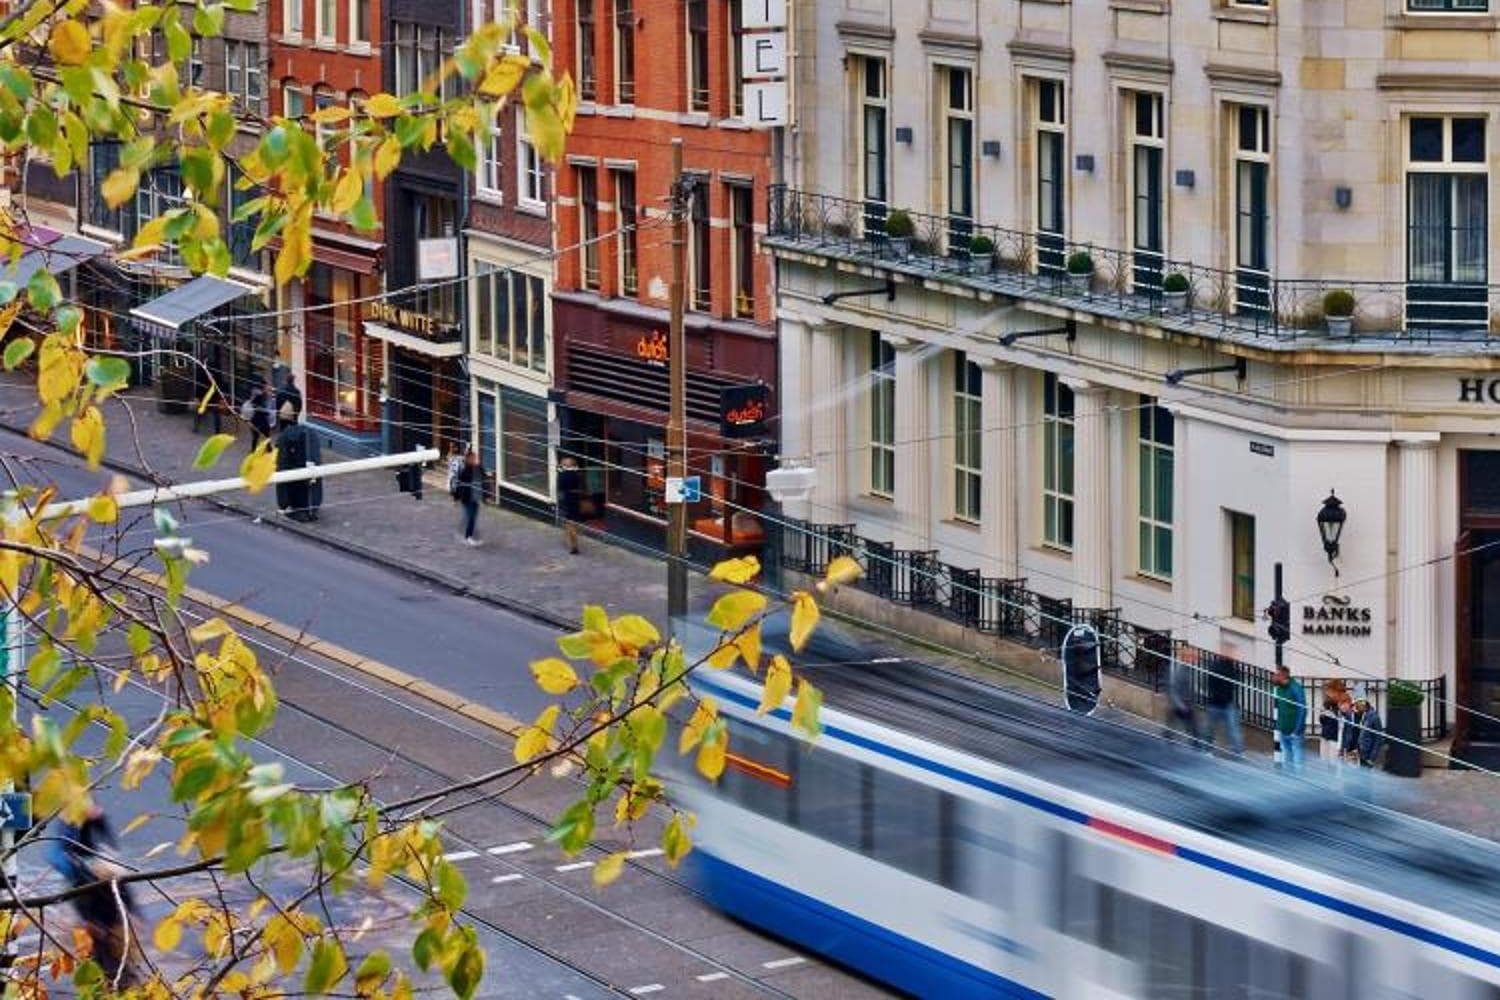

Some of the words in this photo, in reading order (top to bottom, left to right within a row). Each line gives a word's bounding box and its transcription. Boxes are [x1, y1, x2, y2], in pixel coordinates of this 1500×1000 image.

[371, 301, 400, 324] DIRK
[400, 309, 434, 335] WITTE
[1303, 605, 1371, 622] BANKS
[1302, 624, 1371, 637] MANSION
